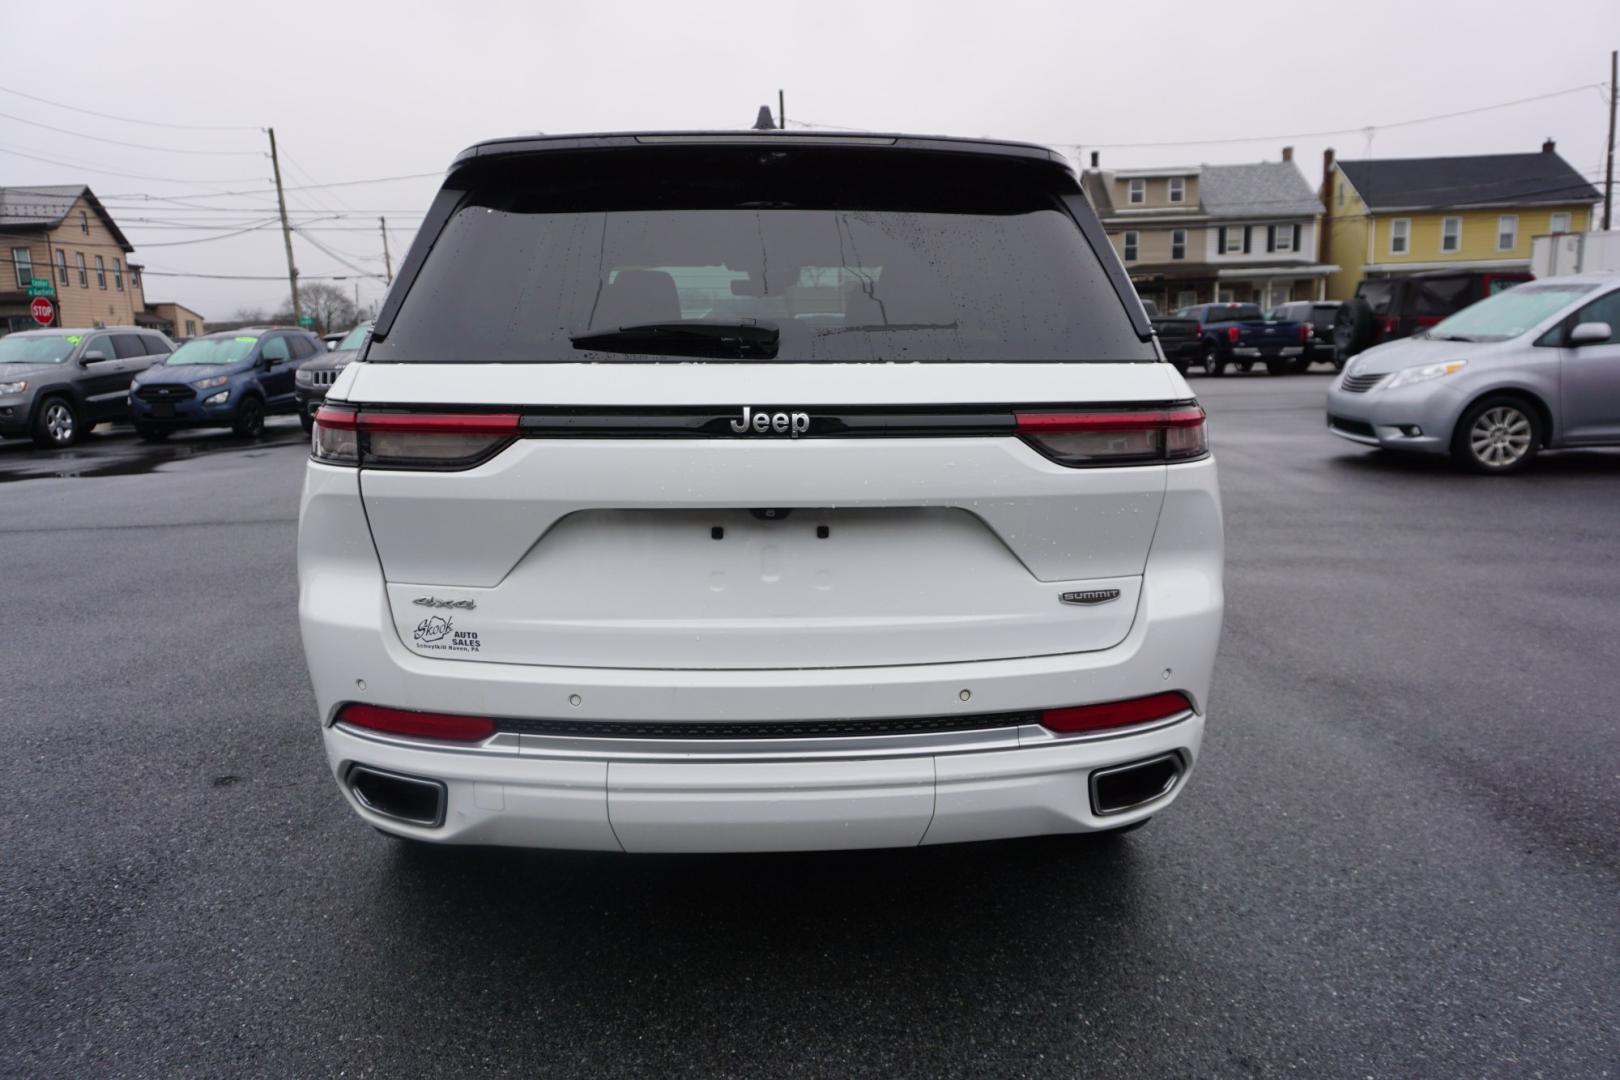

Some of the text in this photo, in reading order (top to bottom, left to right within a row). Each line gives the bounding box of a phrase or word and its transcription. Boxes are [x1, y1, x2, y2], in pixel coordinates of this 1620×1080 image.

[33, 306, 52, 317] STOP
[730, 406, 810, 438] Jeep
[1064, 590, 1118, 600] SUMMIT
[413, 616, 454, 640] Skook
[454, 631, 478, 639] AUTO
[452, 638, 481, 647] SALES
